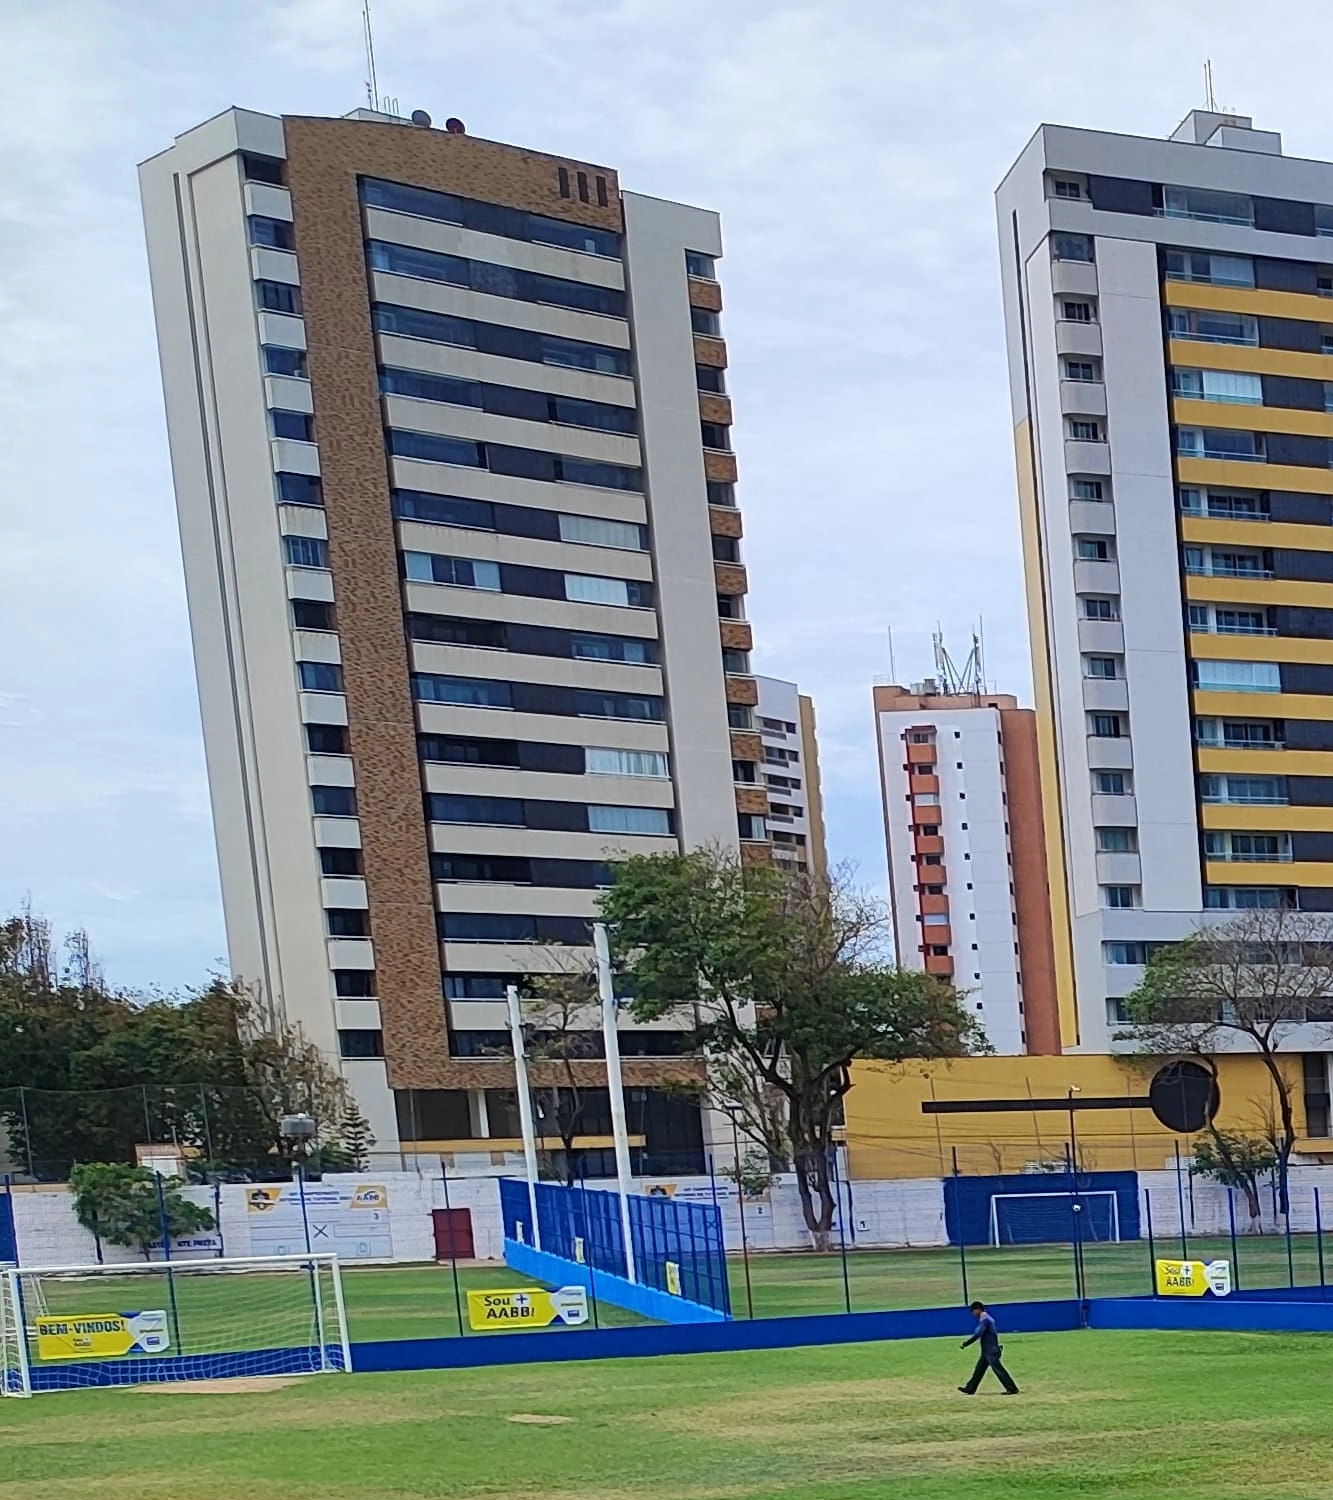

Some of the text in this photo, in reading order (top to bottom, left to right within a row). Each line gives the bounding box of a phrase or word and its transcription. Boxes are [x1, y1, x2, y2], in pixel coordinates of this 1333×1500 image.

[484, 1295, 510, 1307] Sou
[486, 1306, 535, 1319] AABB!
[39, 1319, 126, 1336] BEM-VINDOS!
